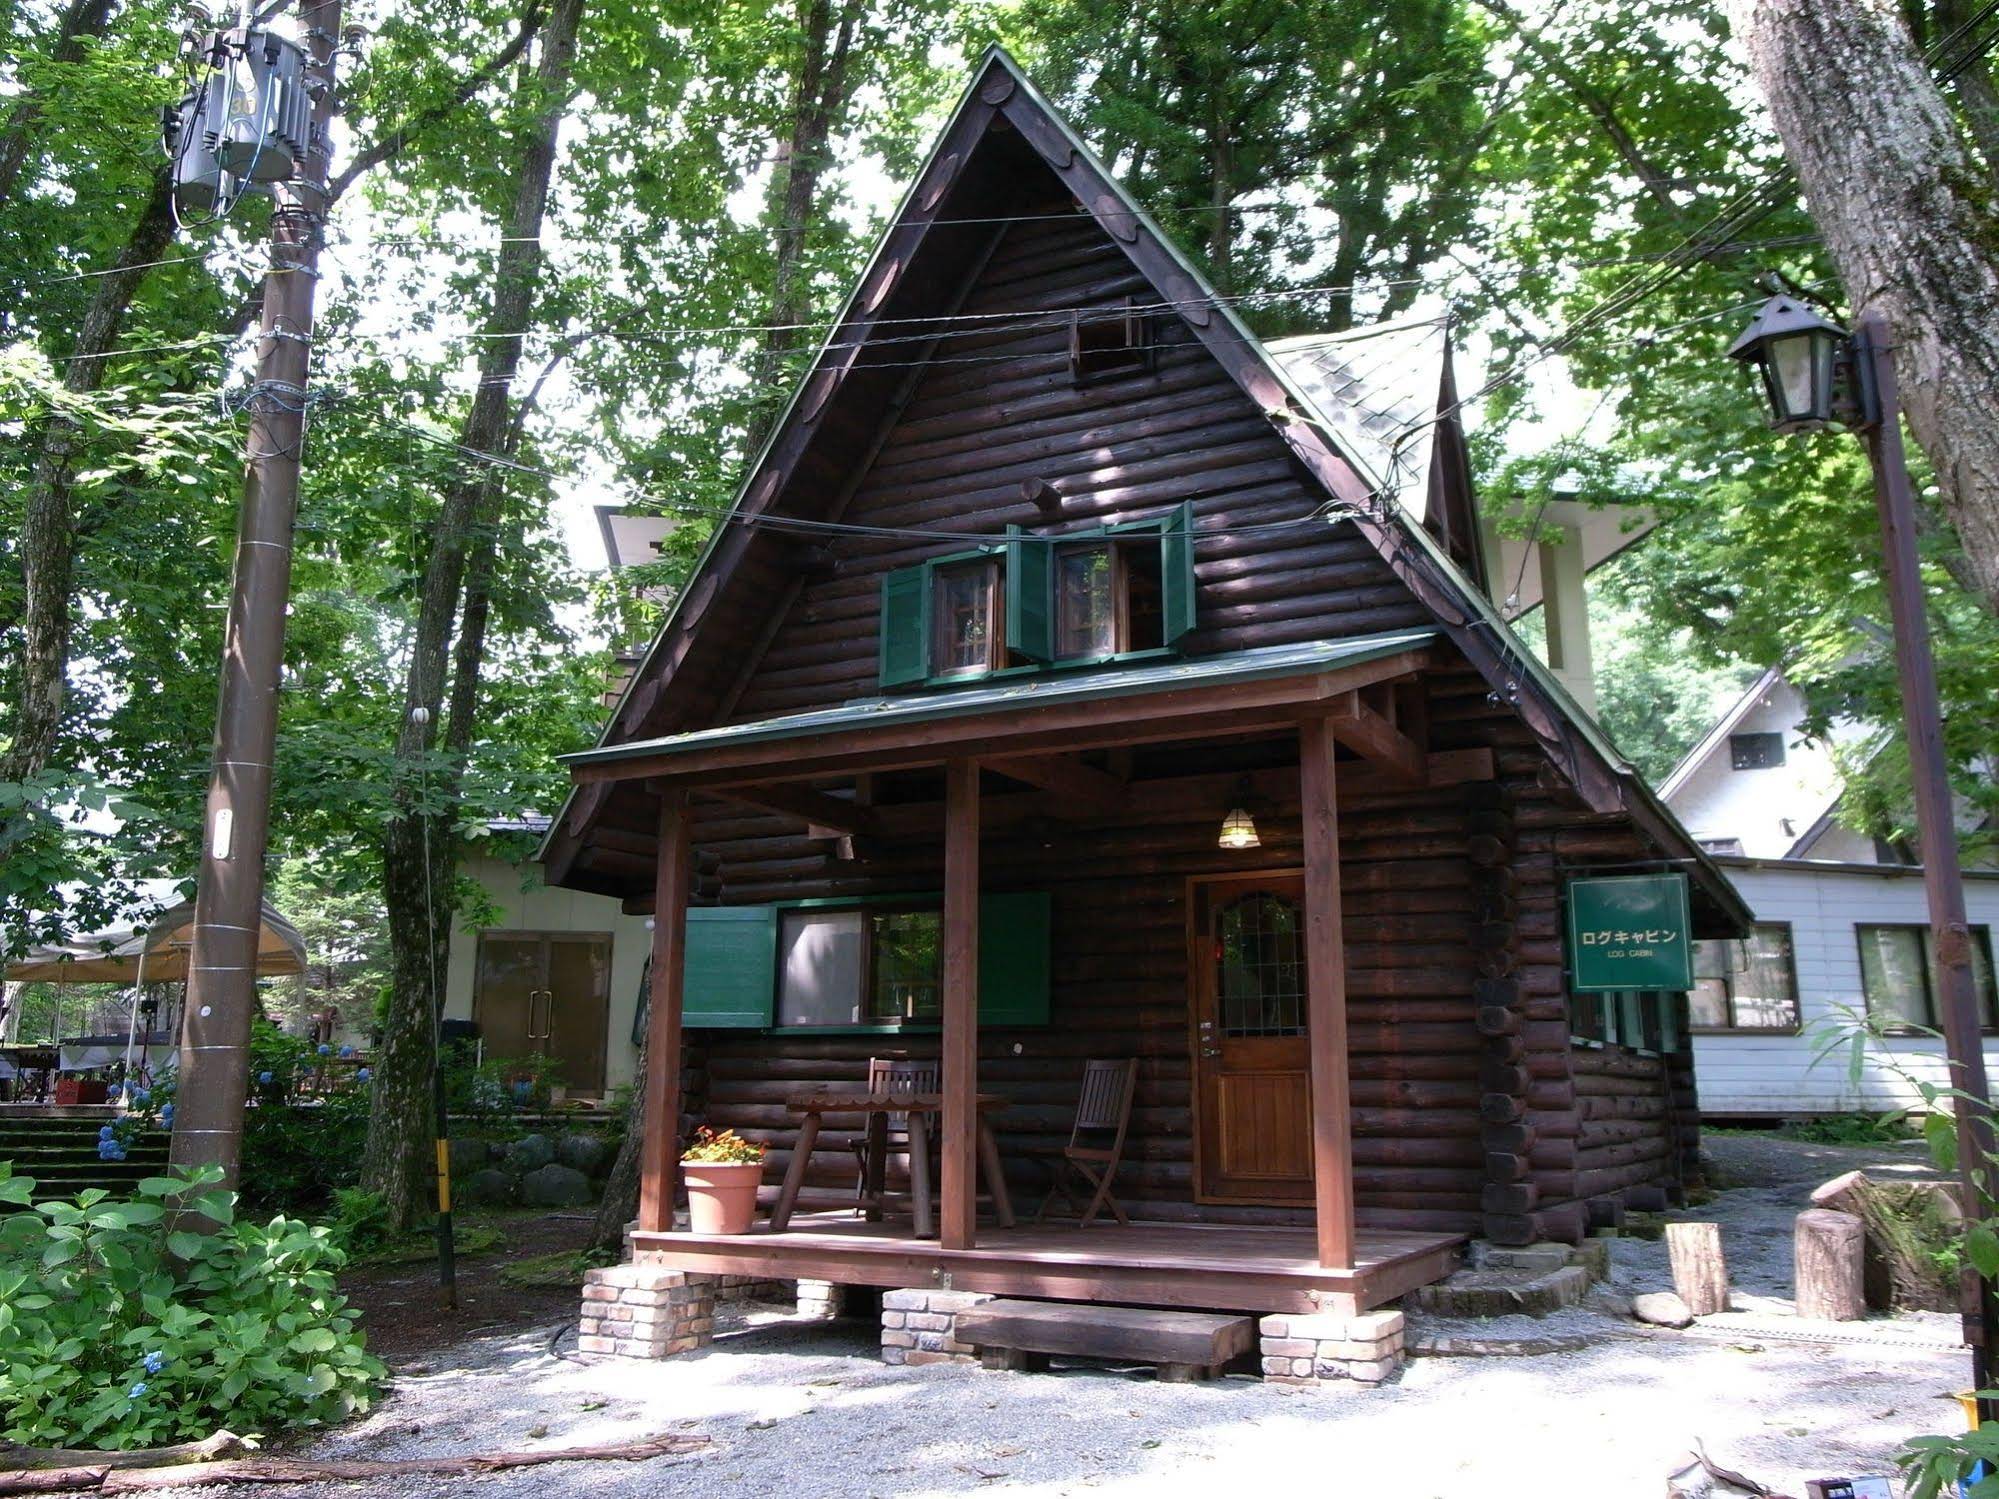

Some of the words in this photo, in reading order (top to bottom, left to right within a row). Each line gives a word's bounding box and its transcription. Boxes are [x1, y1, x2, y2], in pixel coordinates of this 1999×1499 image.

[1583, 930, 1676, 945] ログキャビン
[1607, 950, 1625, 958] LOG
[1629, 949, 1653, 957] CABIN
